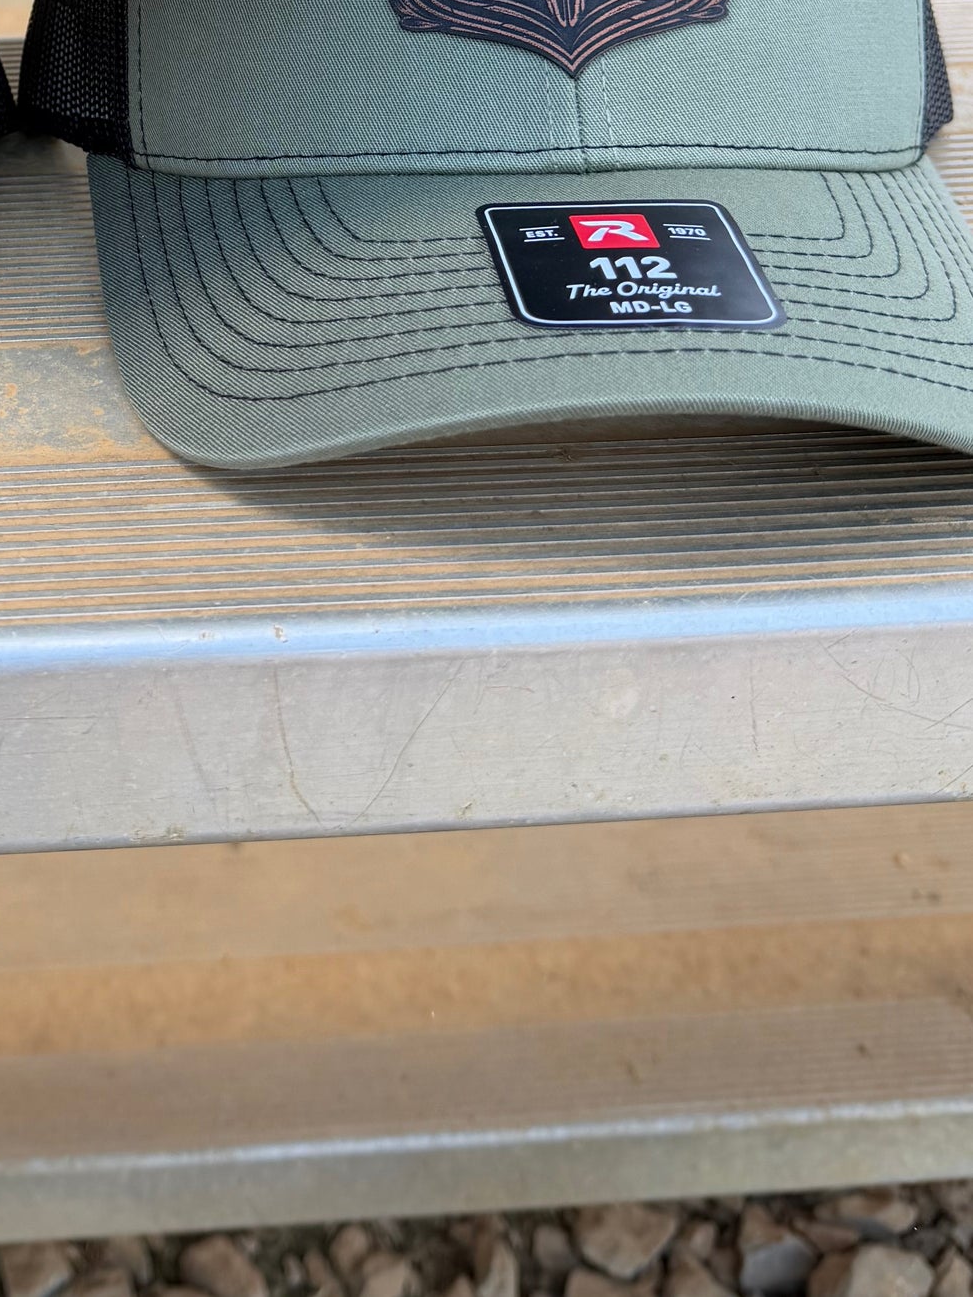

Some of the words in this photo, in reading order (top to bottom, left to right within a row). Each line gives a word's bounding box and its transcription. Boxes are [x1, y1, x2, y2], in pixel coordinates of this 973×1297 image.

[525, 229, 559, 239] EST.
[667, 226, 708, 237] 1970
[589, 256, 677, 280] 112
[565, 283, 612, 300] The
[616, 281, 722, 299] Original
[609, 301, 693, 314] MD-LG
